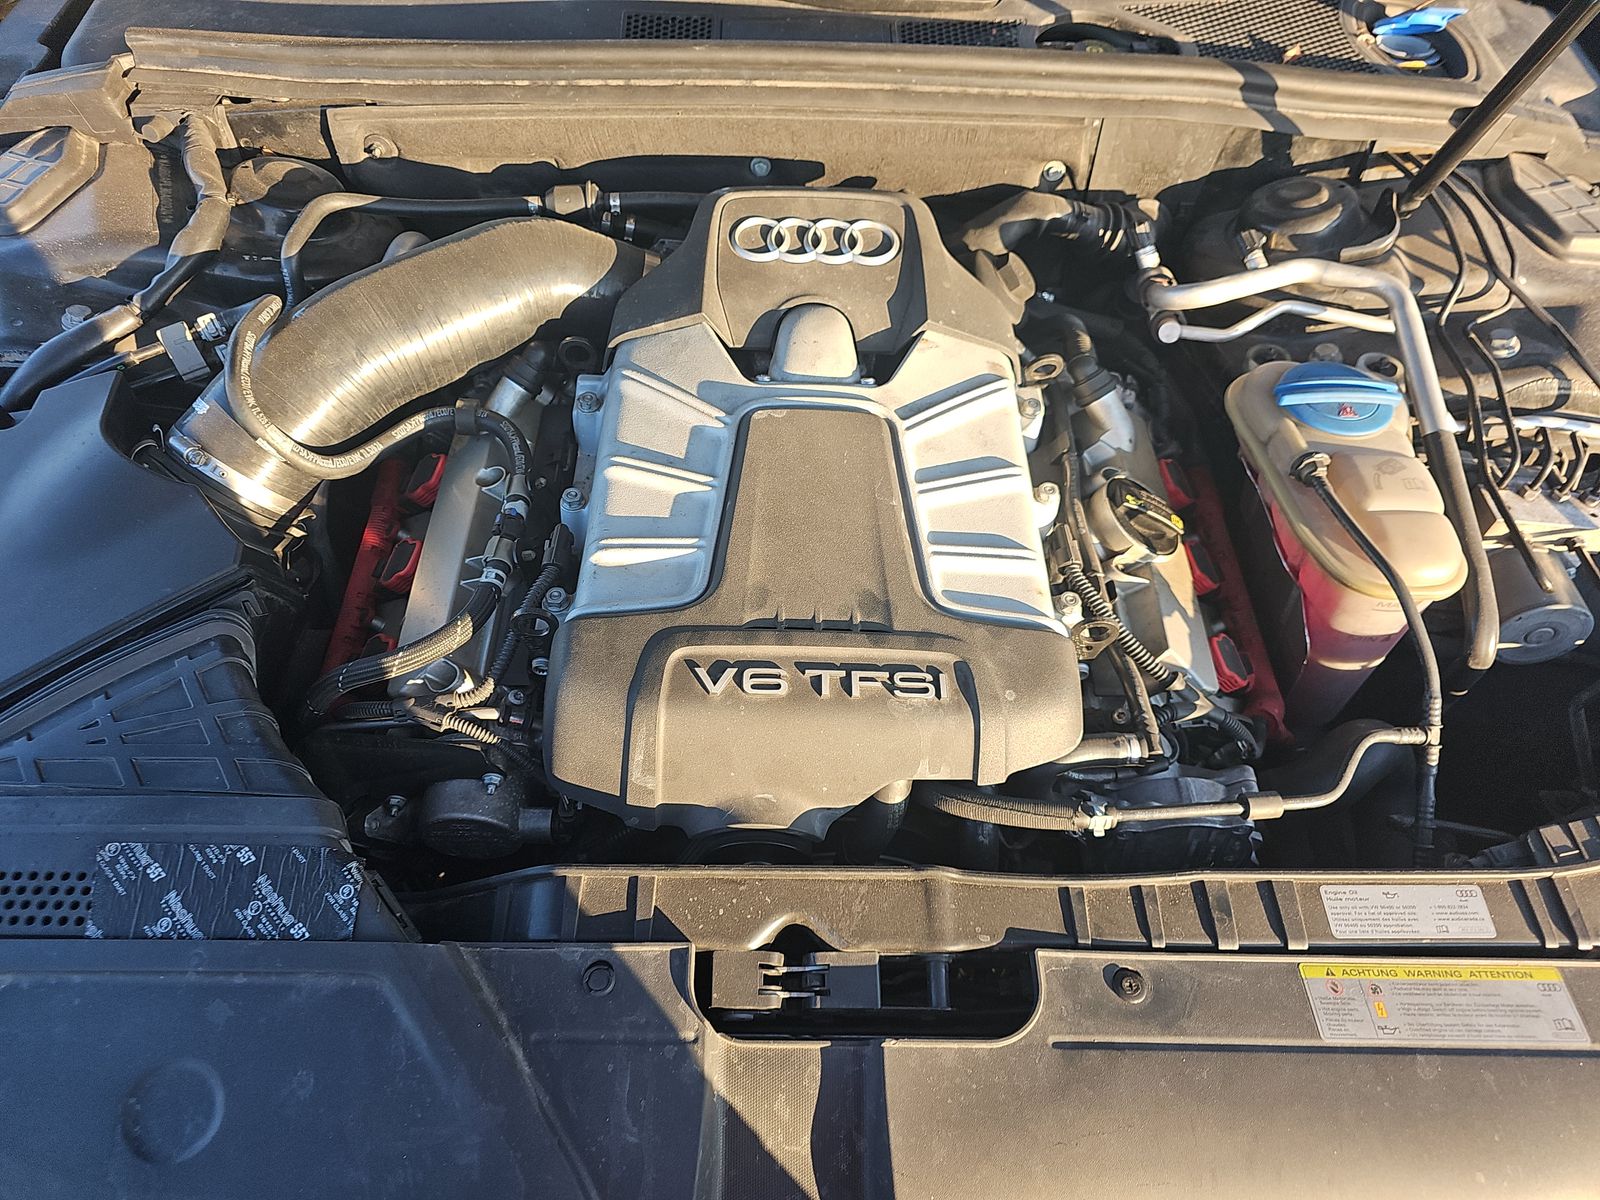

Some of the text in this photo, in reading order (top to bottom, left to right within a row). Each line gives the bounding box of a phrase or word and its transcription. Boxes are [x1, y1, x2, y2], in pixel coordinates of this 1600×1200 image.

[694, 666, 951, 701] V6 TFSI
[236, 846, 256, 866] 557
[292, 848, 307, 864] DUCT
[146, 862, 167, 883] 557
[203, 864, 217, 880] DUCT
[113, 880, 127, 896] DUCT
[254, 872, 312, 942] Nashua 557
[1341, 969, 1534, 979] ACHTUNG WARNING ATTENTION
